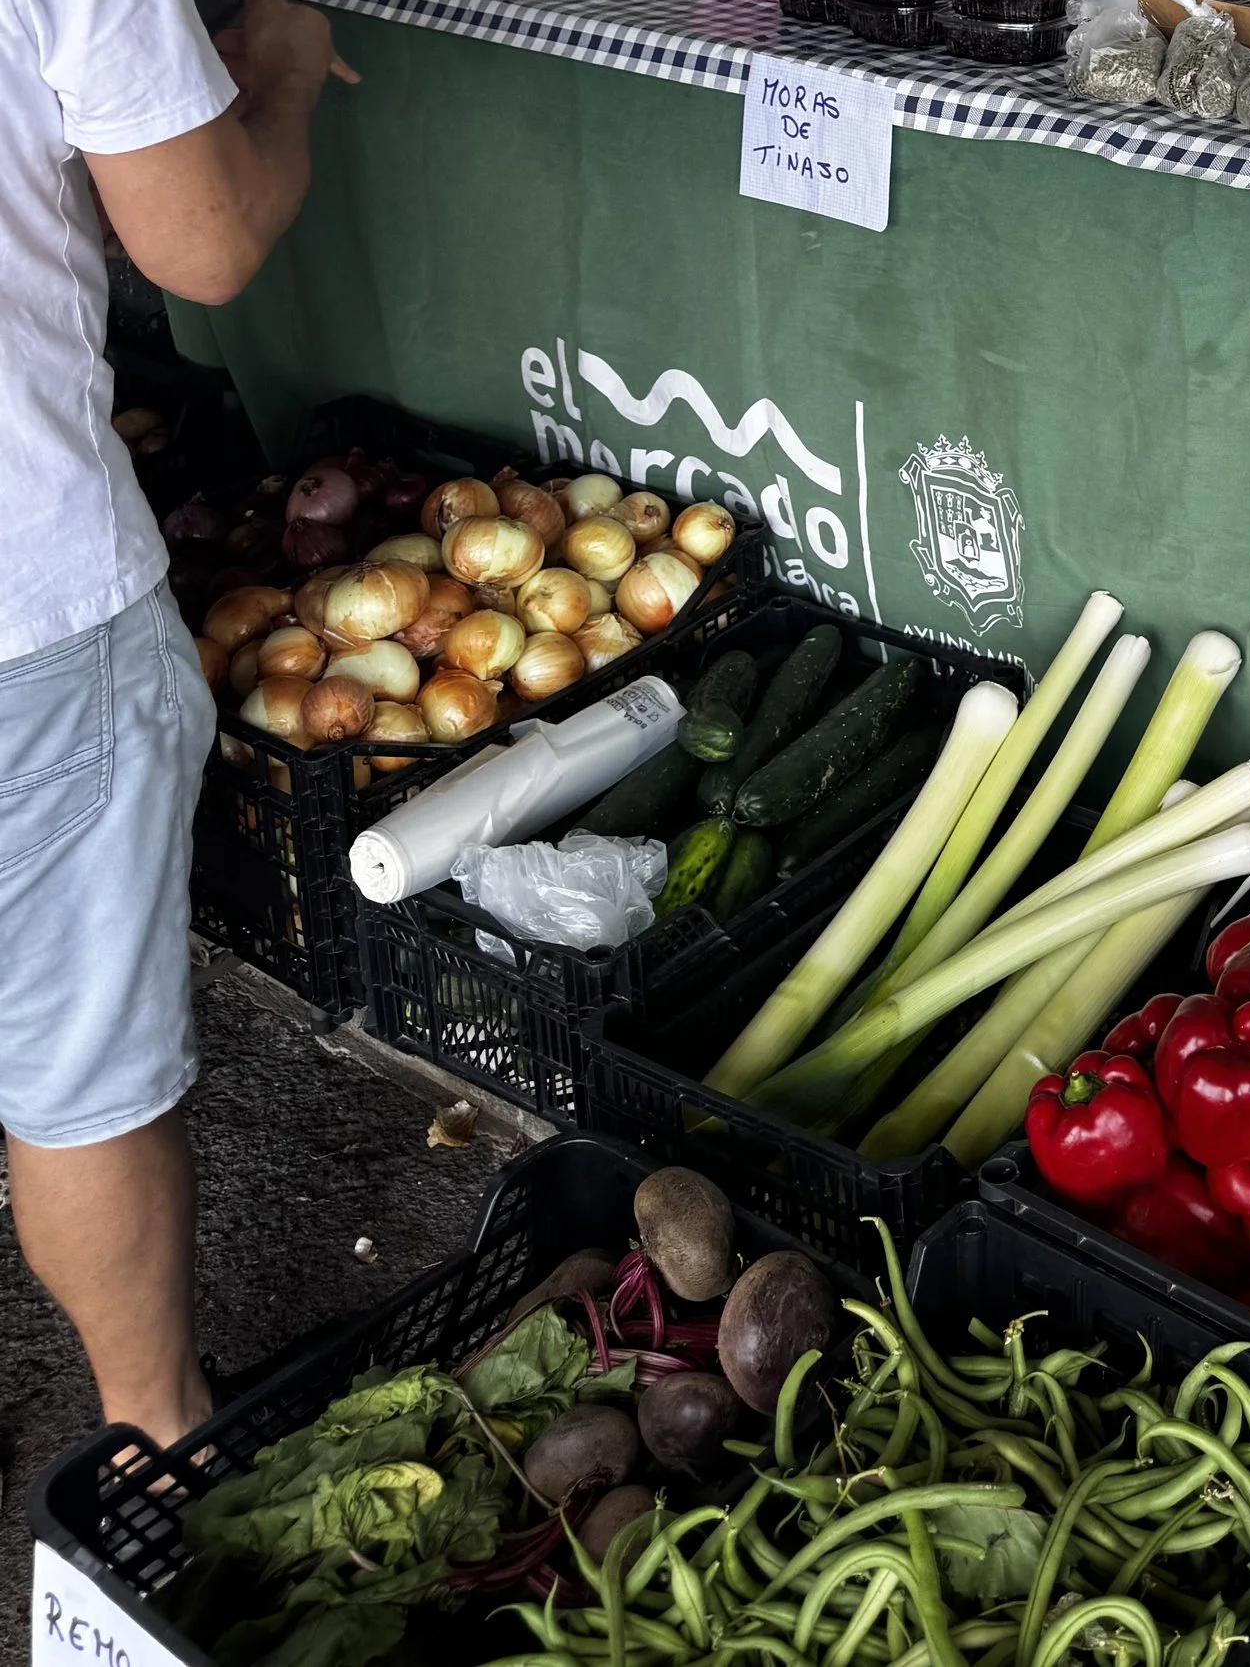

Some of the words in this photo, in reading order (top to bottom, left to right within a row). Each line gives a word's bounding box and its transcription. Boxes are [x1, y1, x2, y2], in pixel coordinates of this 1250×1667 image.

[761, 77, 840, 120] MORAS
[781, 114, 811, 140] DE
[520, 337, 581, 422] el
